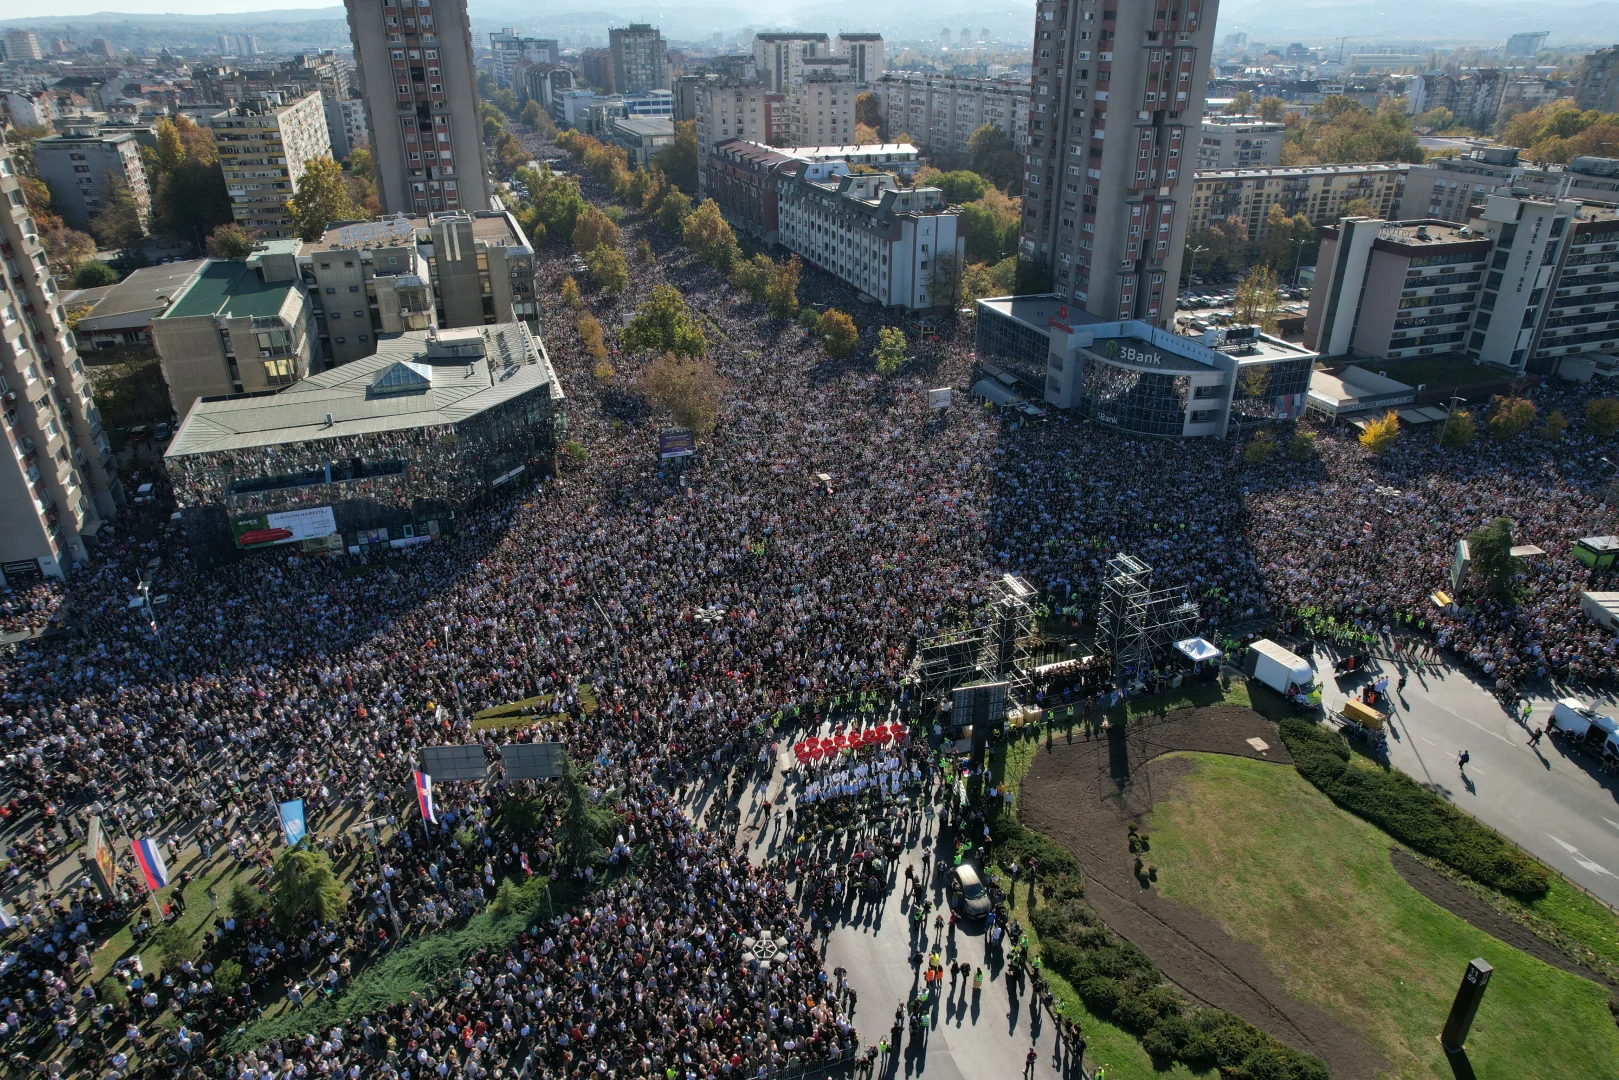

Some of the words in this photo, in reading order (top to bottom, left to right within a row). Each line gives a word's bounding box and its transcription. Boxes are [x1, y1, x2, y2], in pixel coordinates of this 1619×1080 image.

[1531, 216, 1543, 244] HOTEL
[1524, 250, 1533, 271] NOVI
[1516, 277, 1524, 293] SAD
[1120, 346, 1162, 365] 3Bank
[1096, 411, 1118, 425] 3Bank
